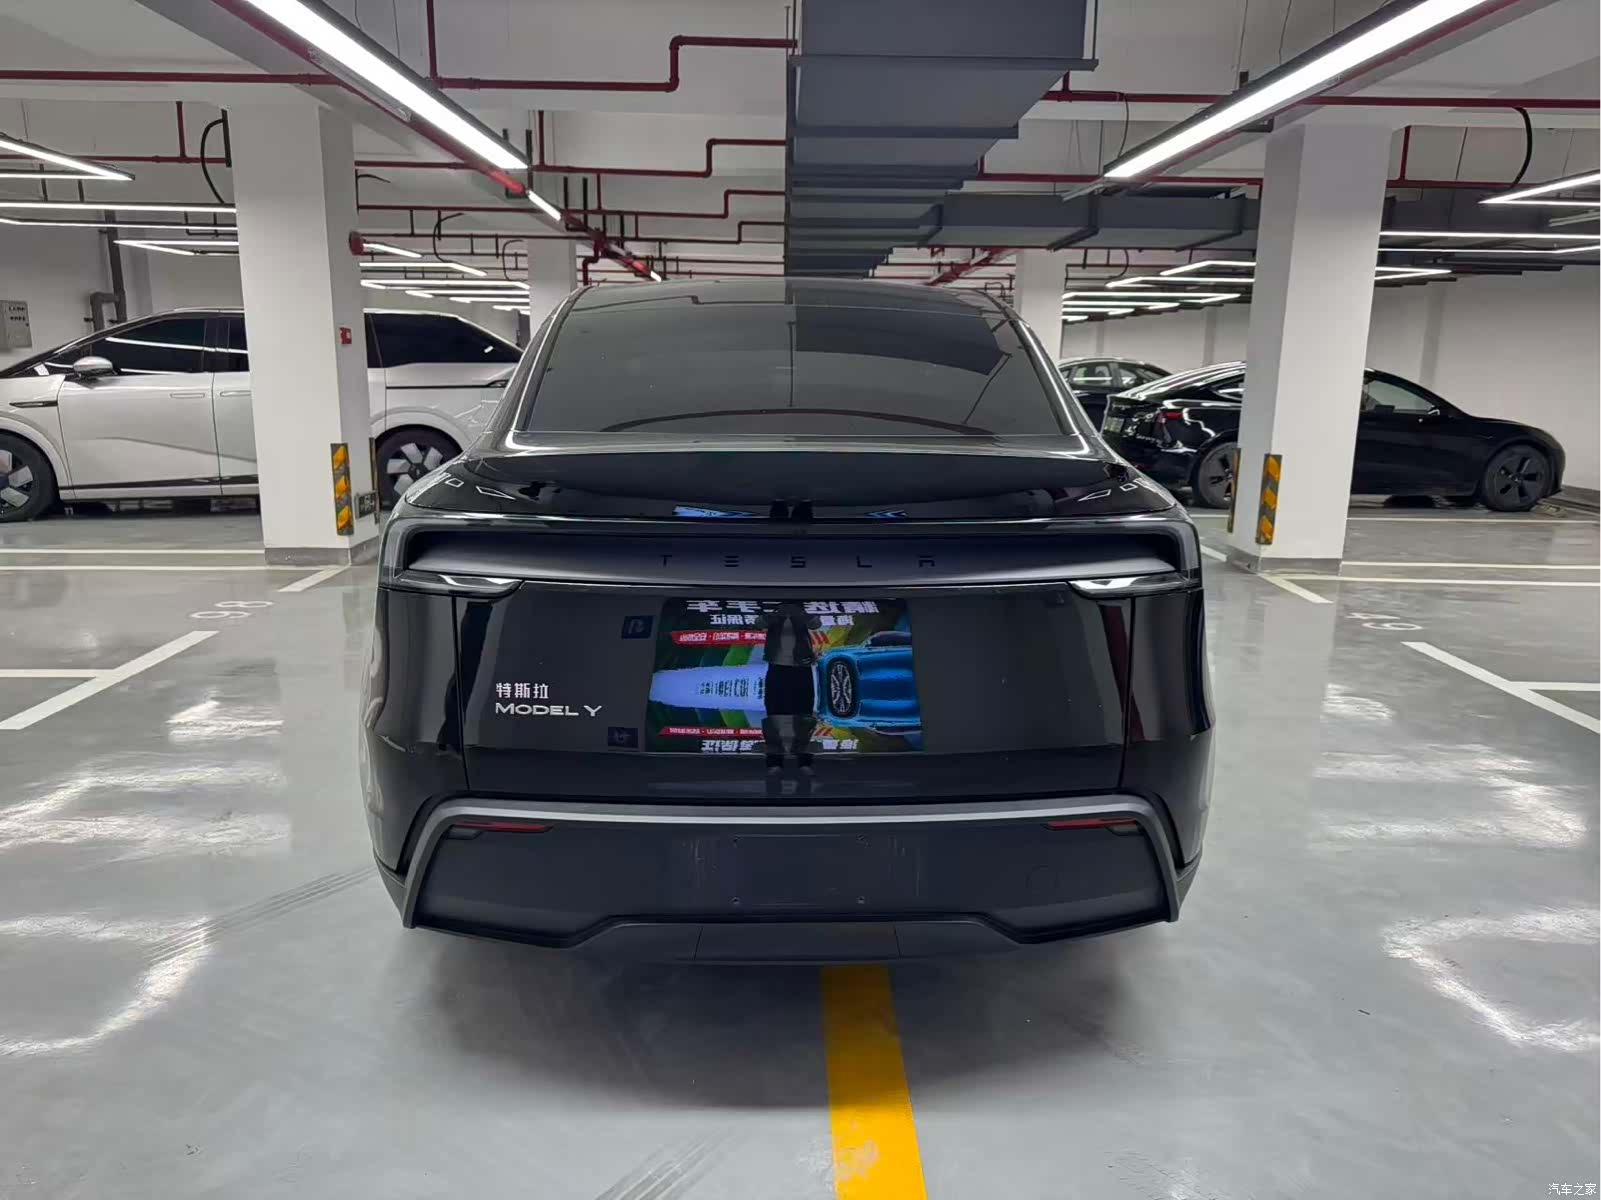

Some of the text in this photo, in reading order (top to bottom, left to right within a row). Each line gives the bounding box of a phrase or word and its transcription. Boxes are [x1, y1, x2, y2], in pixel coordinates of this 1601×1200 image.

[659, 554, 936, 568] TESLA
[496, 682, 549, 699] 特斯拉
[496, 702, 602, 717] MODEL Y
